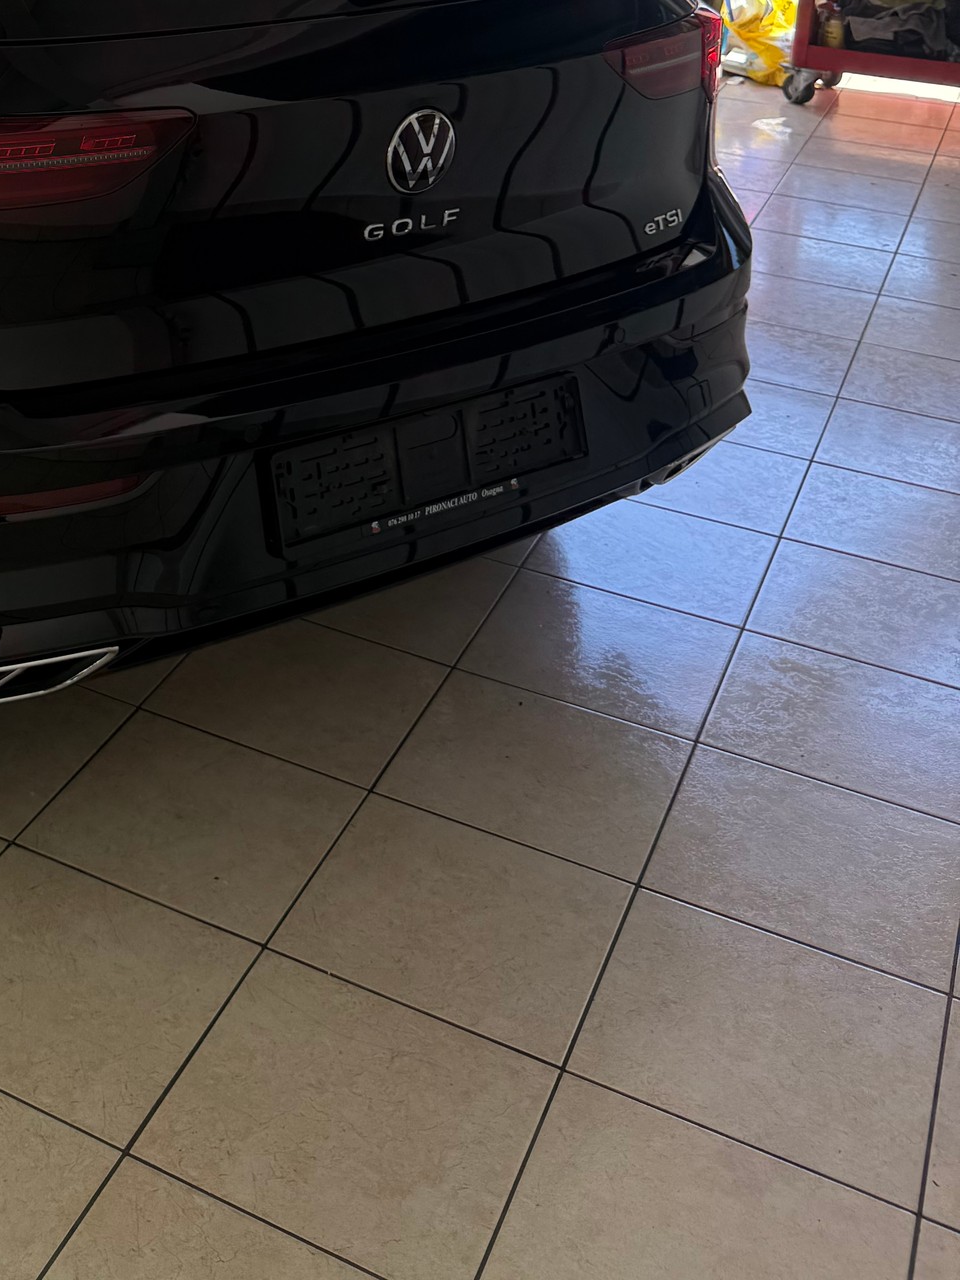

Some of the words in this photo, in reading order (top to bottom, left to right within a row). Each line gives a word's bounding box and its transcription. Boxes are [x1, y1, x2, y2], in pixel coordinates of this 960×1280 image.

[363, 208, 461, 241] GOLF
[644, 208, 684, 236] eTSI
[425, 499, 459, 515] PIRONACI
[459, 492, 478, 505] AUTO
